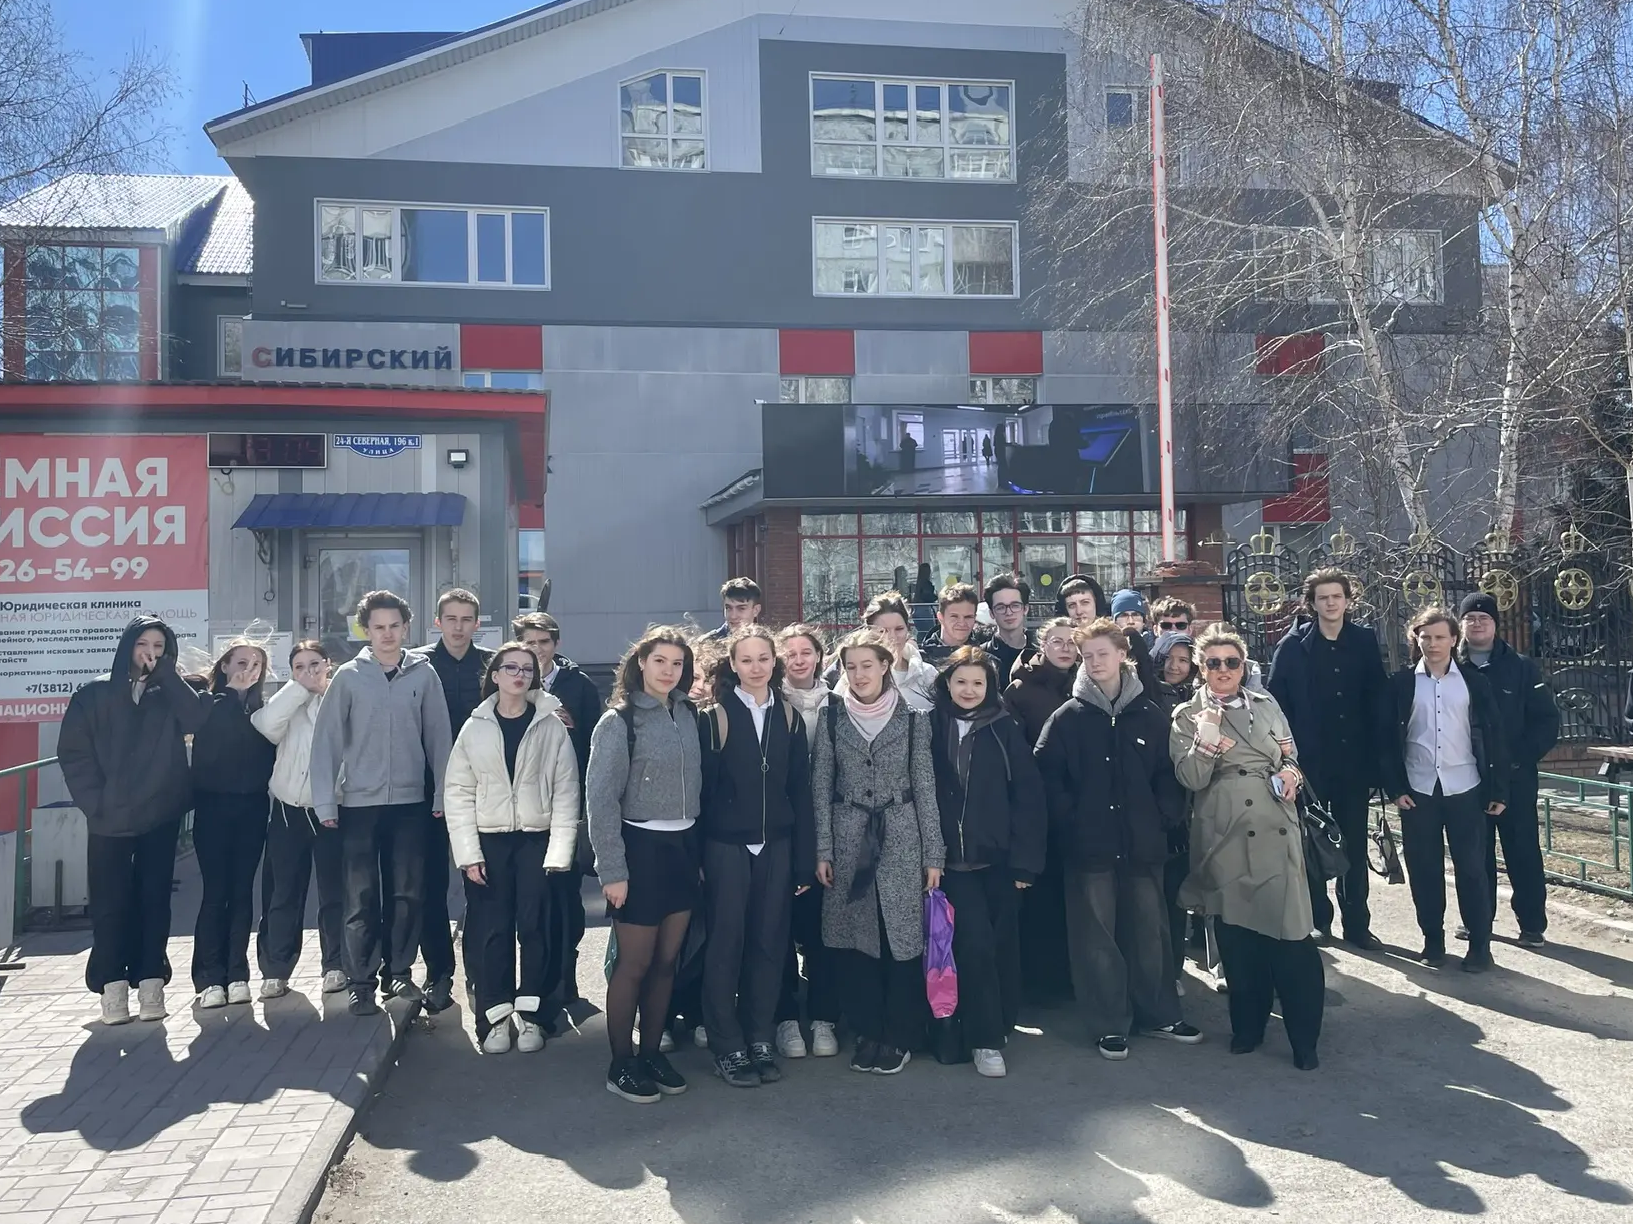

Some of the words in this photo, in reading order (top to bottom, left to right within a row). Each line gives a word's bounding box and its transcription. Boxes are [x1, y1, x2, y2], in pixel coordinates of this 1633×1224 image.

[251, 345, 452, 370] СИБИРСКИЙ
[335, 436, 352, 445] 24-Я
[394, 437, 407, 446] 196
[363, 447, 394, 455] УЛИЦА
[5, 457, 168, 498] МНАЯ
[0, 601, 88, 613] Юридическая
[90, 600, 142, 609] клиника
[30, 609, 130, 622] ЮРИДИЧЕСКАЯ
[28, 629, 68, 637] граждан
[37, 635, 114, 643] наследственного
[25, 682, 73, 695] +7(3812)
[0, 702, 69, 718] АЦИОН
